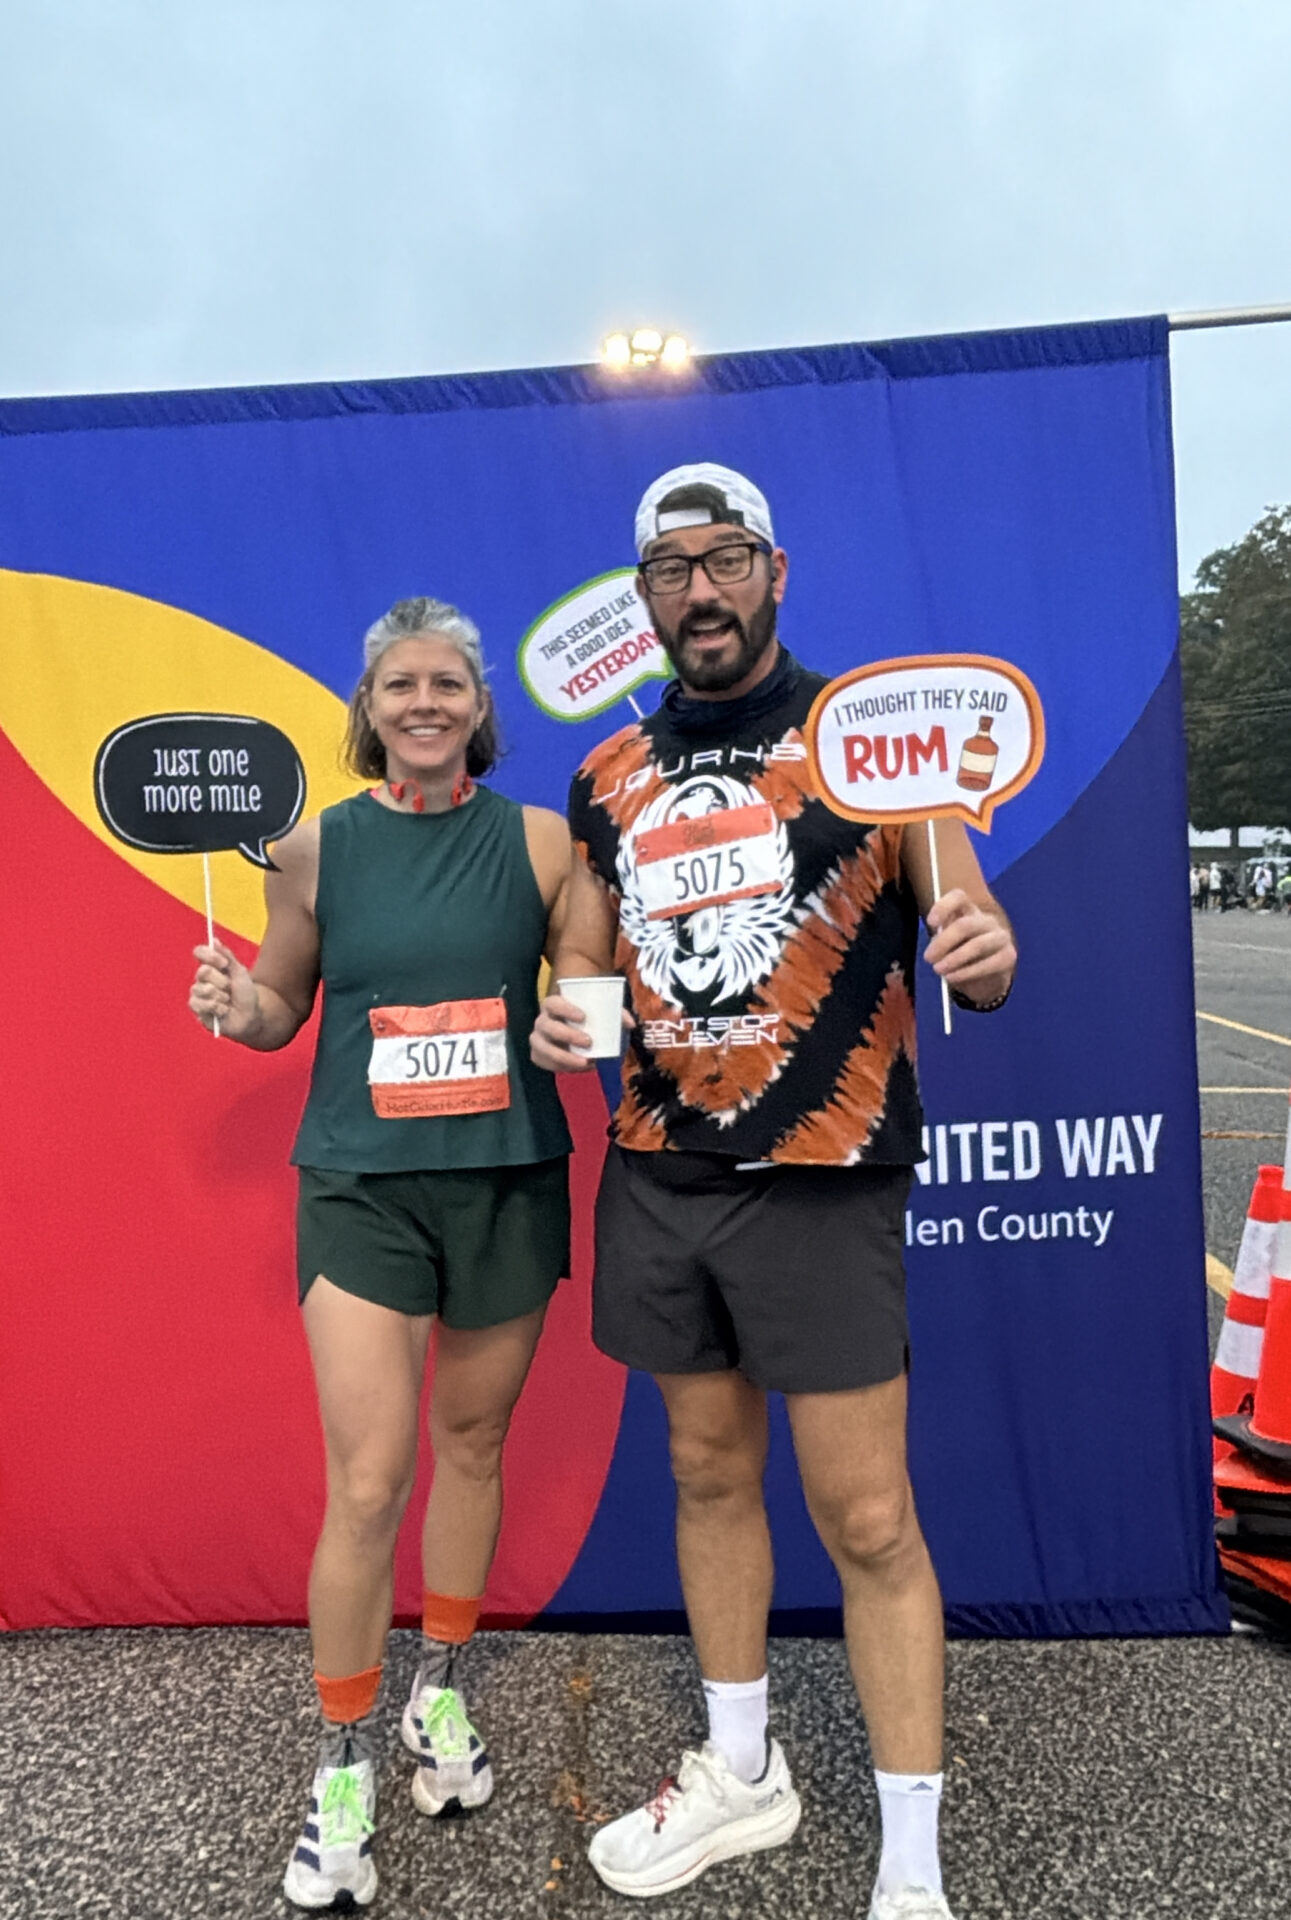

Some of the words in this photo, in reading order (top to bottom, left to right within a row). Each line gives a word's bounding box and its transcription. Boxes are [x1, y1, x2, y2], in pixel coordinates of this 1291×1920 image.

[538, 635, 569, 661] THIS
[565, 607, 612, 644] SEEMED
[609, 590, 637, 616] LIKE
[564, 653, 578, 669] A
[575, 634, 607, 662] GOOD
[604, 617, 634, 644] IDEA
[834, 708, 842, 727] I
[842, 691, 917, 725] THOUGHT
[921, 689, 965, 711] THEY
[968, 689, 1008, 713] SAID
[153, 749, 201, 777] JUST
[842, 725, 948, 784] RUM
[673, 847, 745, 900] 5075
[707, 1014, 780, 1031] STOP
[405, 1038, 477, 1079] 5074
[1055, 1113, 1163, 1178] WAY
[977, 1205, 1114, 1247] County
